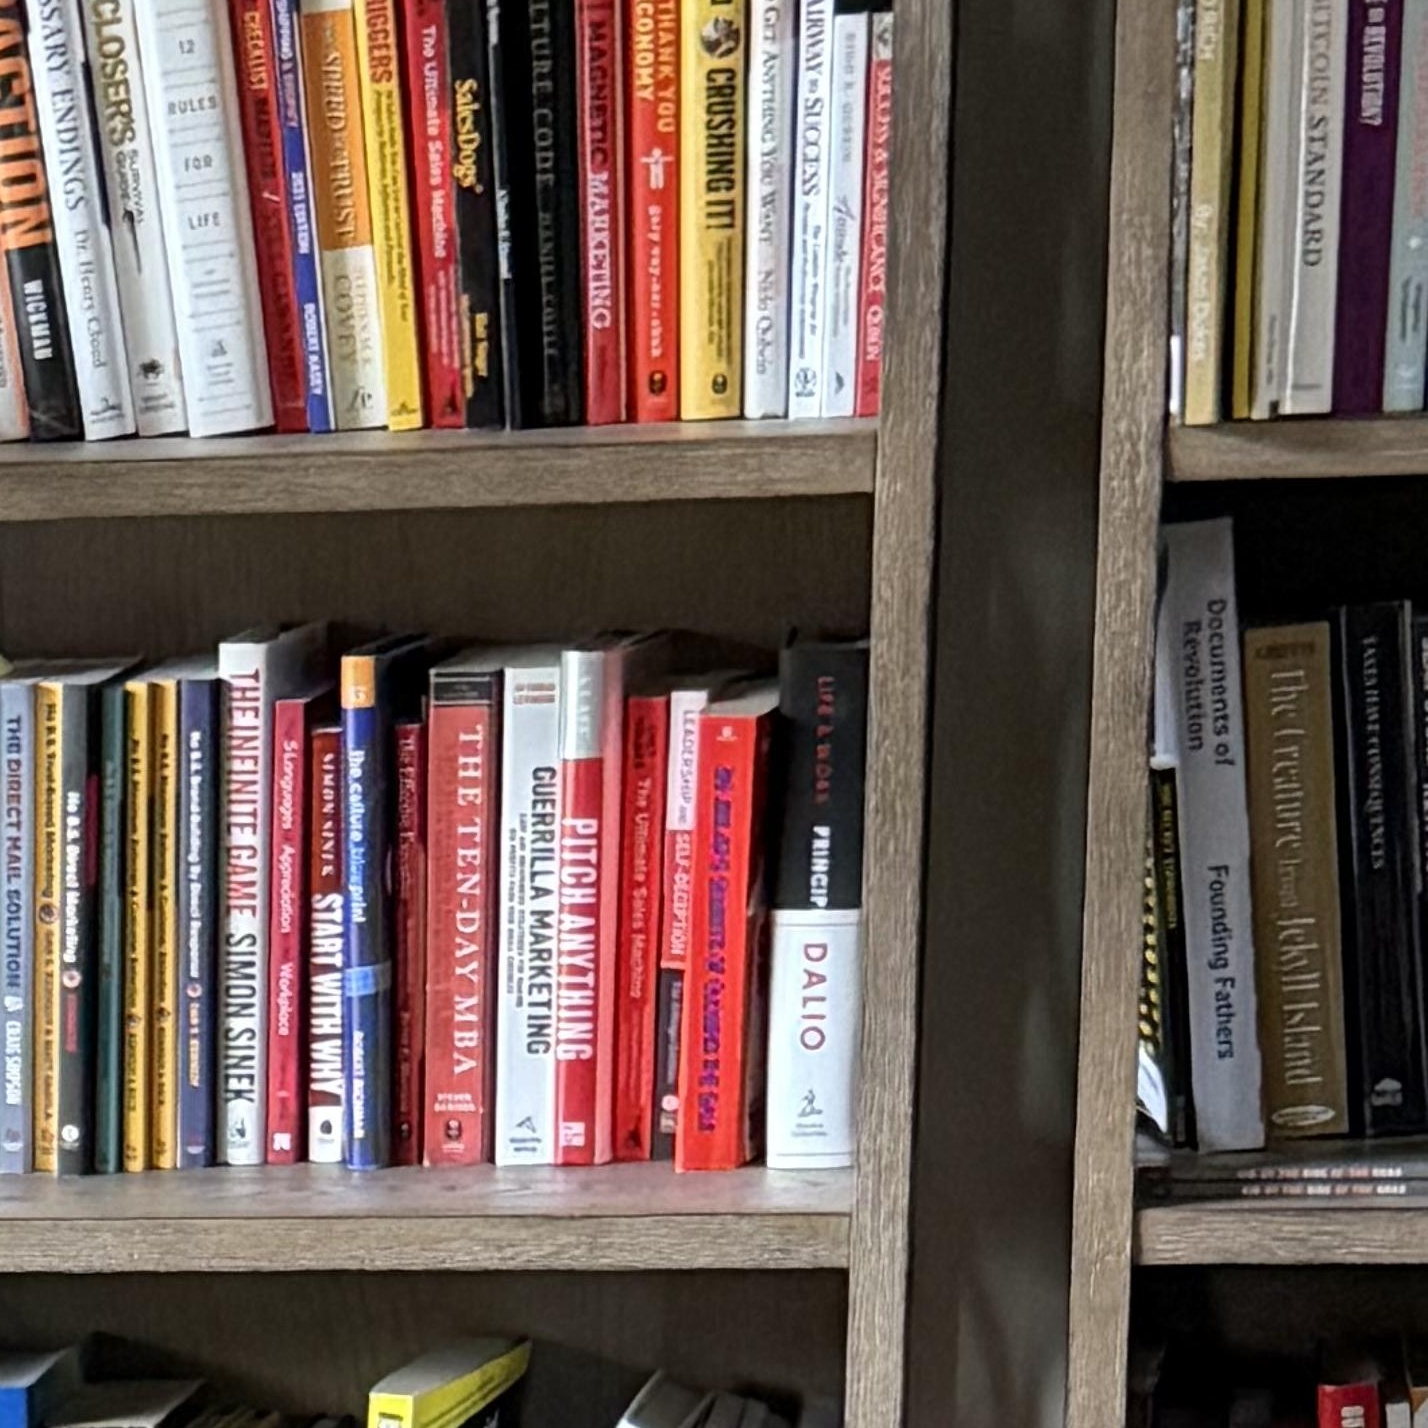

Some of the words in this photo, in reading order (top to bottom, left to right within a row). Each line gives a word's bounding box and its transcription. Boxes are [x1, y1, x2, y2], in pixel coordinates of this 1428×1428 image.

[245, 11, 268, 90] CHECKLIST
[421, 25, 439, 58] The
[762, 6, 780, 44] GET
[168, 103, 217, 116] RULES
[424, 63, 443, 137] Ultimate
[588, 21, 609, 166] MAGNETIC
[656, 89, 674, 133] YOU
[760, 50, 779, 143] ANYTHING
[1358, 25, 1387, 126] REVOLUTION?
[49, 89, 86, 213] ENDINGS
[185, 158, 212, 172] FOR
[426, 141, 445, 185] Sales
[452, 78, 481, 188] SalesDogs
[706, 67, 736, 193] CRUSHING
[760, 148, 778, 186] YOU
[800, 97, 823, 197] SUCCESS
[187, 216, 222, 228] LIFE
[326, 158, 354, 240] TRUST
[430, 189, 449, 258] Machine
[706, 199, 736, 230] IT!
[758, 190, 777, 246] WANT
[1301, 115, 1328, 268] STANDARD
[589, 170, 611, 329] MARKETING
[23, 280, 53, 360] WICKMAN
[333, 274, 356, 364] COVEY
[227, 670, 260, 719] THE
[1181, 620, 1206, 752] Revolution
[1206, 598, 1233, 738] Documents
[1268, 668, 1310, 717] The
[6, 715, 22, 755] THE
[458, 724, 483, 806] THE
[1212, 743, 1236, 768] of
[6, 758, 22, 831] DIRECT
[226, 724, 259, 836] INFINITE
[636, 778, 650, 807] The
[1271, 727, 1312, 850] Creature
[6, 836, 22, 885] MAIL
[529, 767, 557, 900] GUERRILLA
[560, 818, 598, 902] PITCH
[632, 813, 649, 882] Ultimate
[226, 844, 258, 918] GAME
[455, 818, 480, 983] TEN-DAY
[632, 888, 647, 929] Sales
[669, 833, 691, 955] SELF-DECEPTION
[1206, 864, 1231, 972] Founding
[6, 889, 22, 989] SOLUTION
[311, 893, 342, 968] START
[629, 934, 645, 999] Machine
[1274, 915, 1320, 991] Jekyll
[224, 932, 256, 1019] SIMON
[311, 973, 341, 1035] WITH
[526, 910, 554, 1055] MARKETING
[556, 912, 594, 1061] ANYTHING
[799, 942, 829, 1051] DALIO
[452, 996, 478, 1076] MBA
[1212, 977, 1237, 1061] Fathers
[1280, 1001, 1324, 1088] Island
[224, 1027, 255, 1103] SINEK
[311, 1040, 340, 1094] WHY
